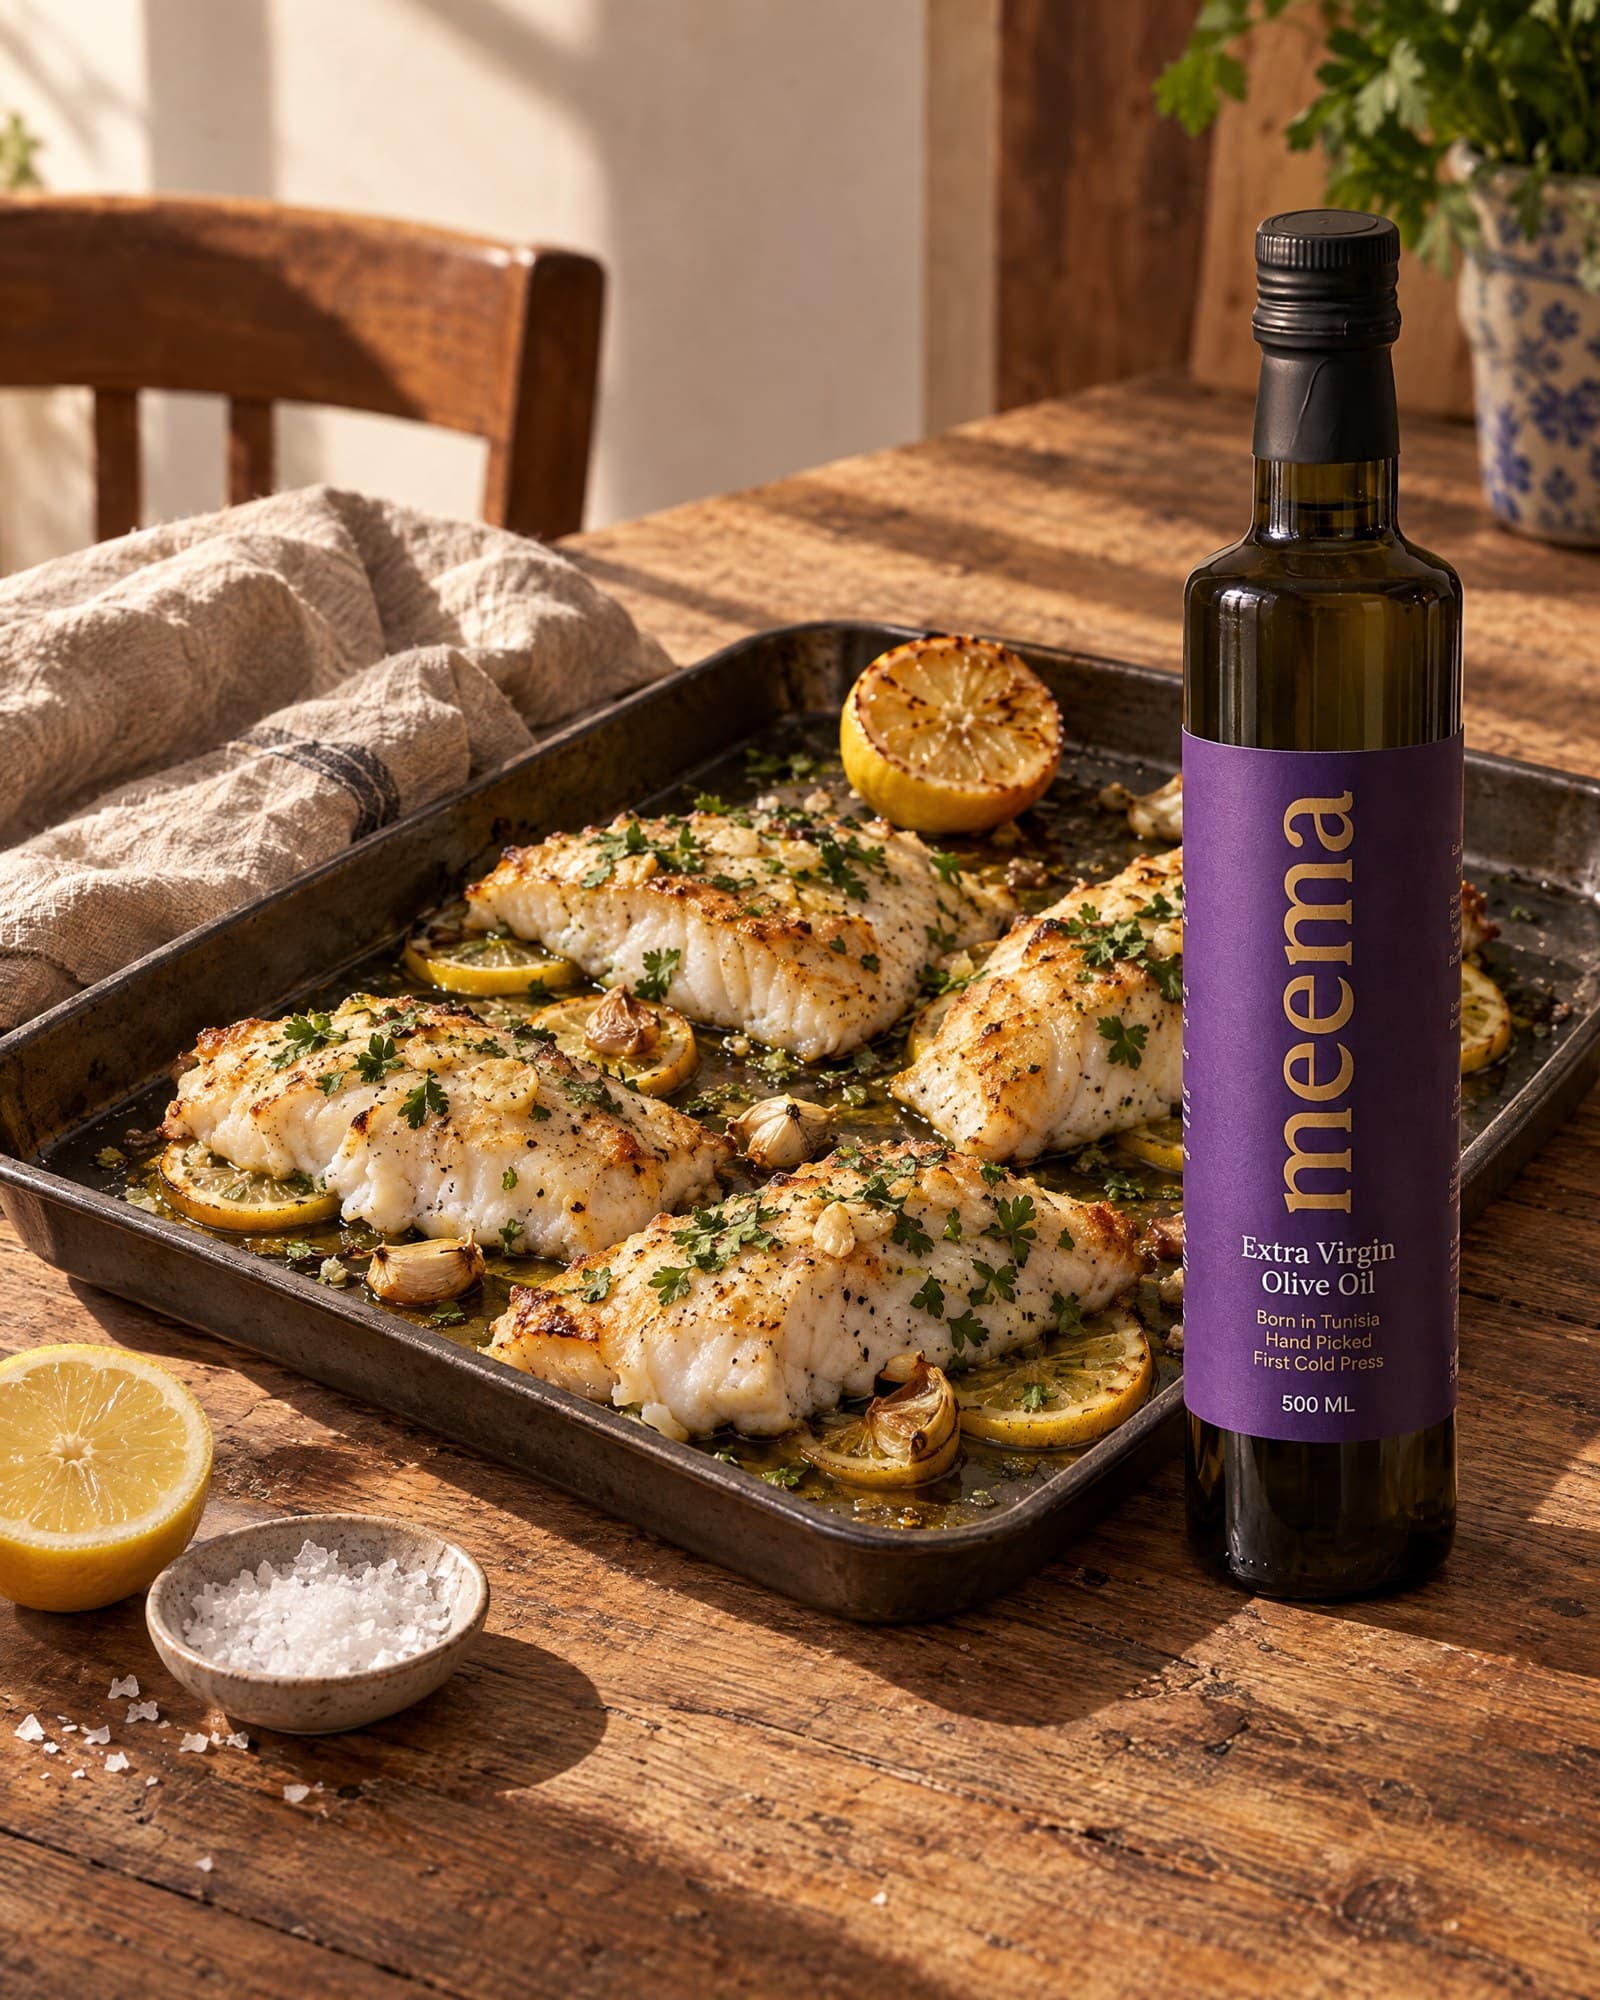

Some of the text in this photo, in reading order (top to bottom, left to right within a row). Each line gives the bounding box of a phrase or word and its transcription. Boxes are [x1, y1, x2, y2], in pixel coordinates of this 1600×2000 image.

[1283, 790, 1355, 1214] meema
[1241, 1234, 1397, 1269] Extra Virgin
[1262, 1270, 1376, 1296] Olive Oil
[1256, 1309, 1380, 1330] Born in Tunisia
[1265, 1330, 1372, 1350] Hand Picked
[1253, 1350, 1384, 1372] First Cold Press
[1281, 1394, 1356, 1413] 500 ML
